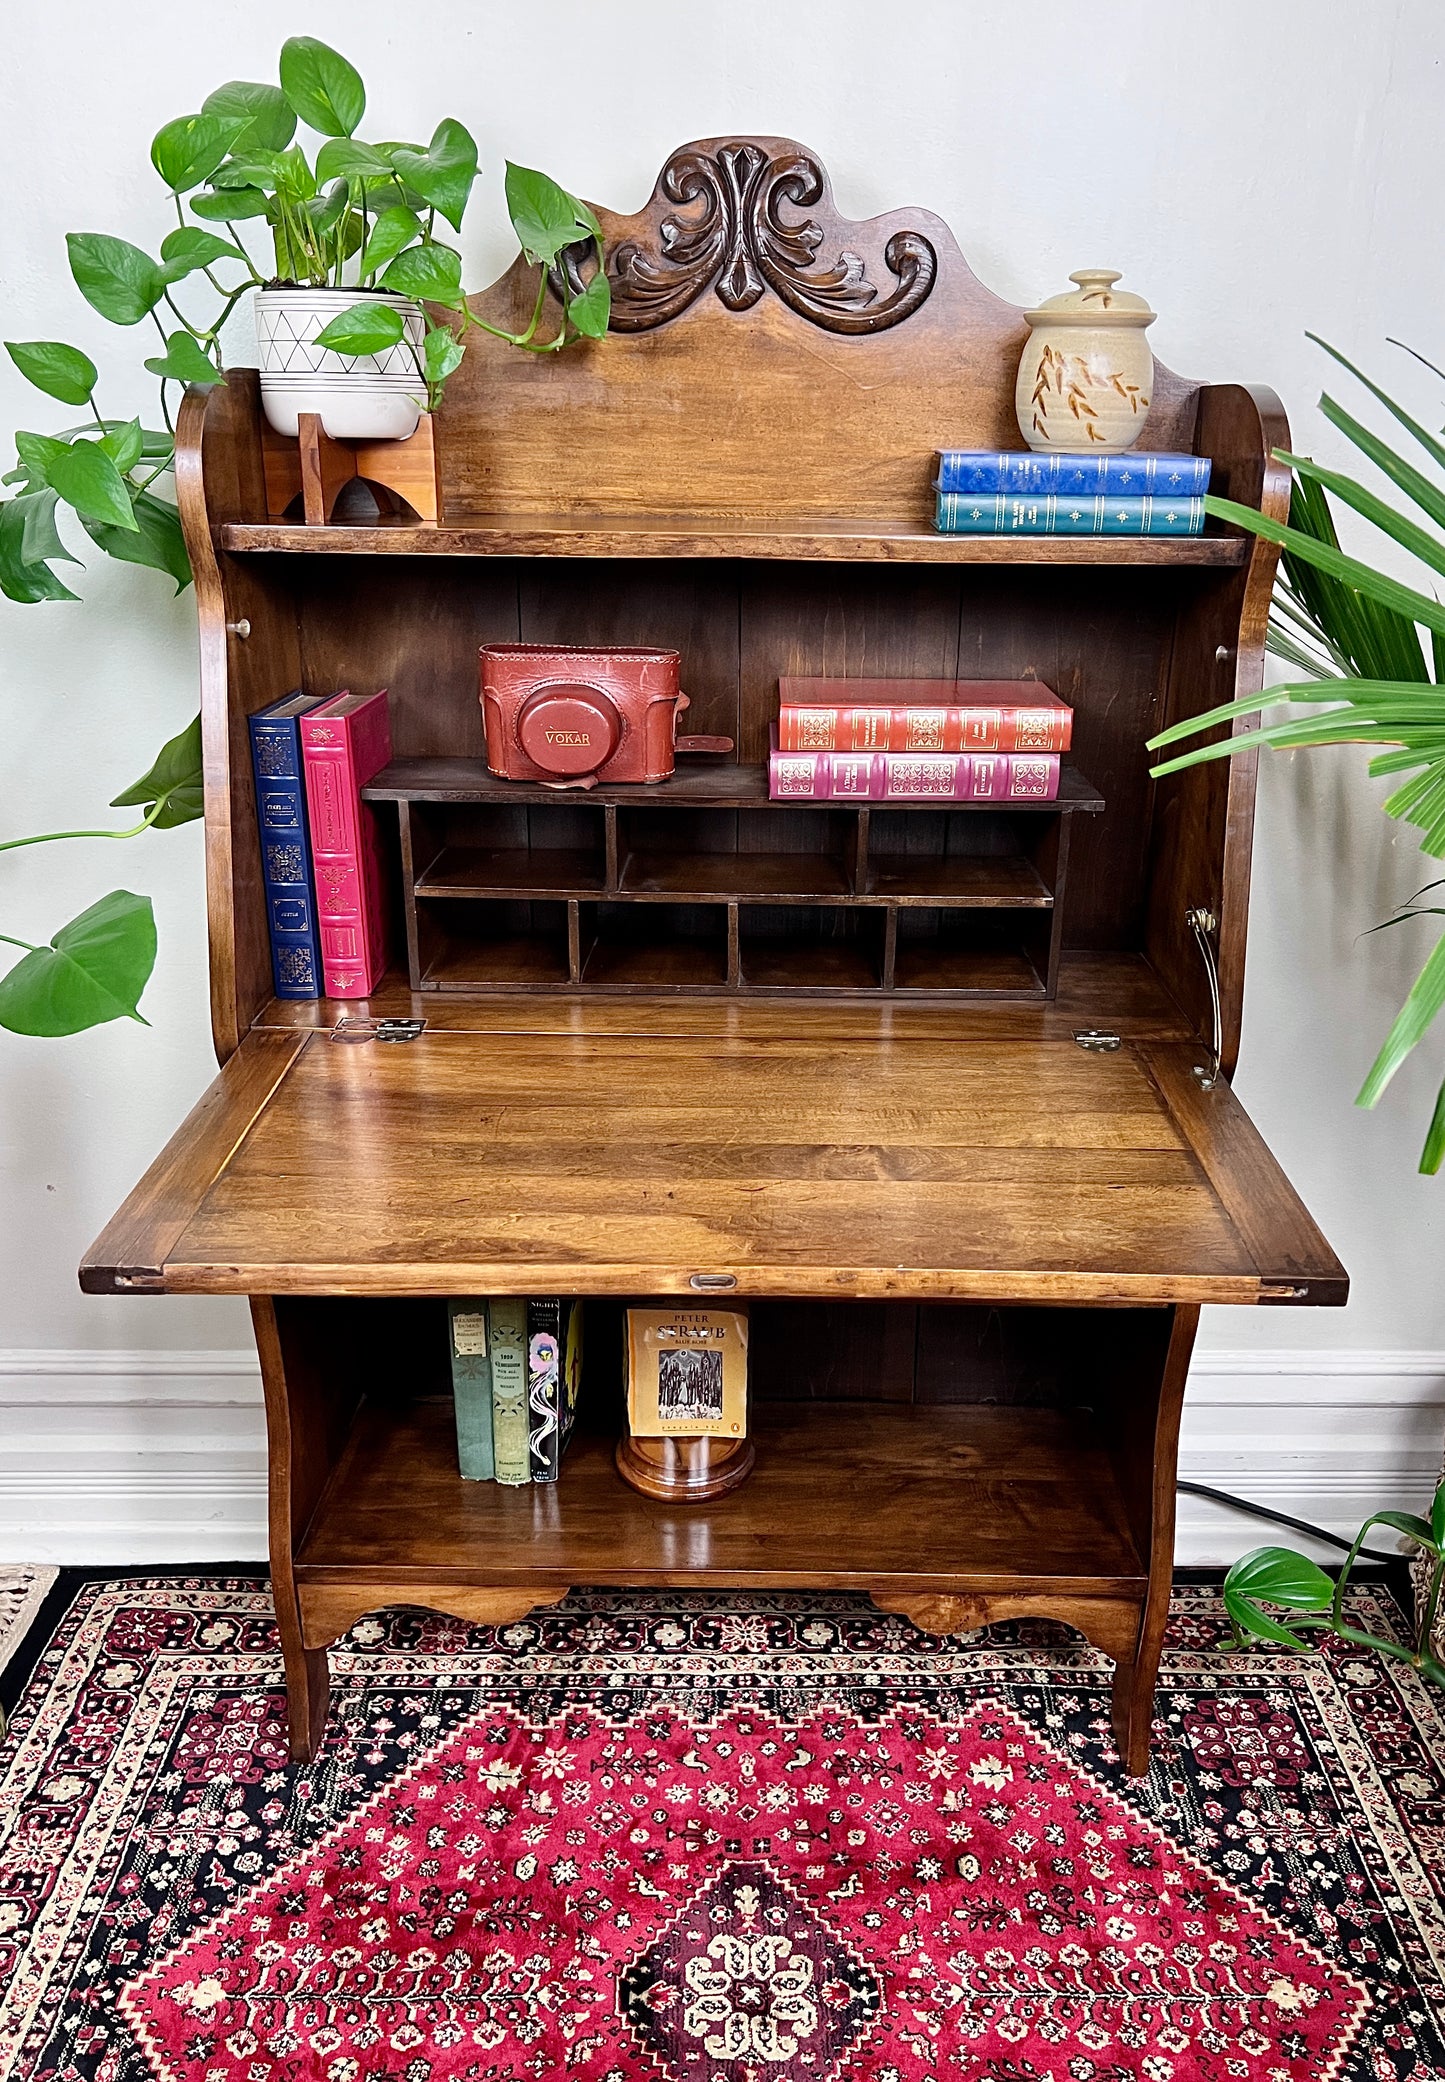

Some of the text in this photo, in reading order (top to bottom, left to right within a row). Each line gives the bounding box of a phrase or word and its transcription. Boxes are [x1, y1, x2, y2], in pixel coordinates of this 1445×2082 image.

[545, 732, 590, 746] VOKAR
[674, 1315, 709, 1323] PETER
[657, 1325, 725, 1339] STRAUB
